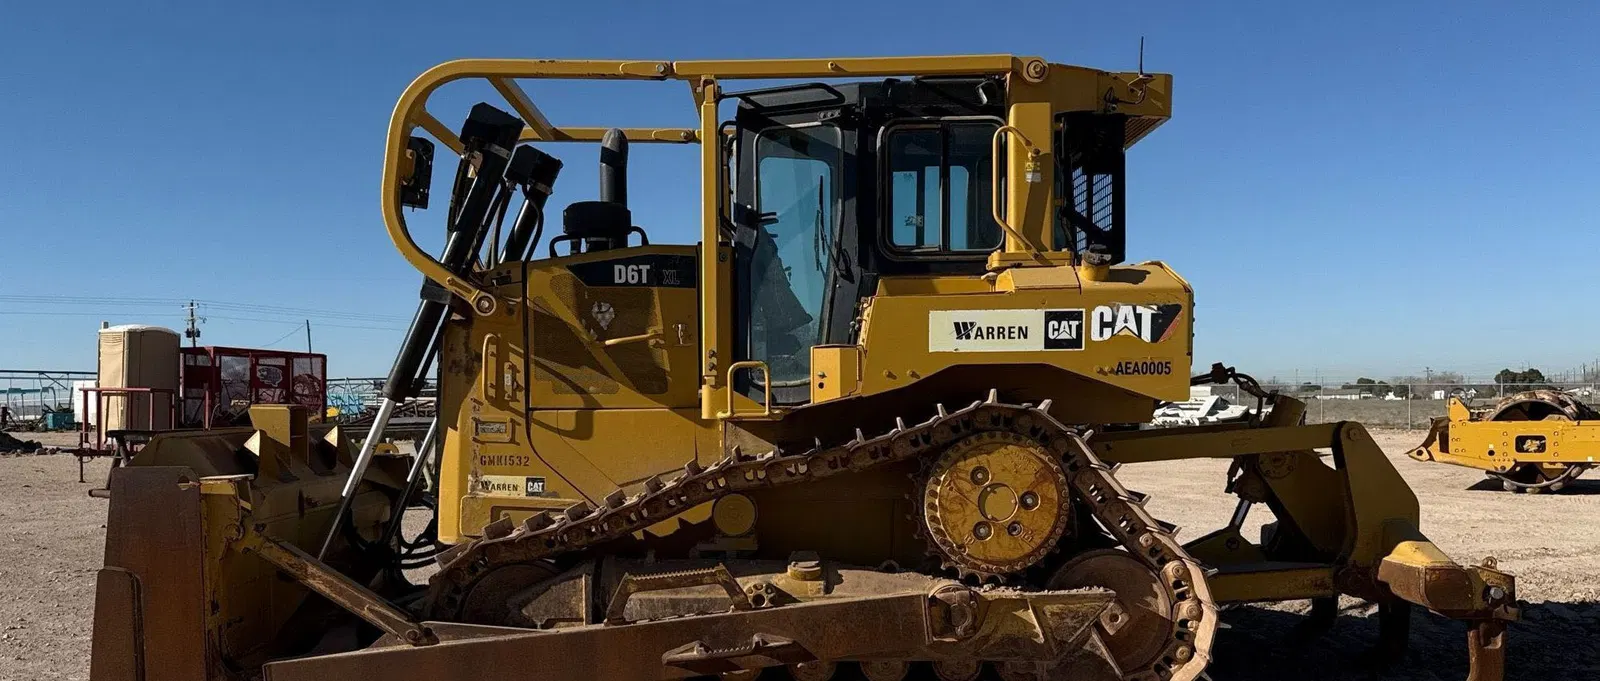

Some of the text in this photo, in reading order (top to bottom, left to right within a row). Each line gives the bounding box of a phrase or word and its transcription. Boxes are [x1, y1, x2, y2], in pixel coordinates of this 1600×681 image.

[614, 264, 680, 285] D6T XL
[953, 320, 1079, 340] WARREN CAT
[1091, 305, 1158, 343] CAT
[1115, 361, 1172, 375] AEA0005
[480, 480, 543, 492] WARREN CAT
